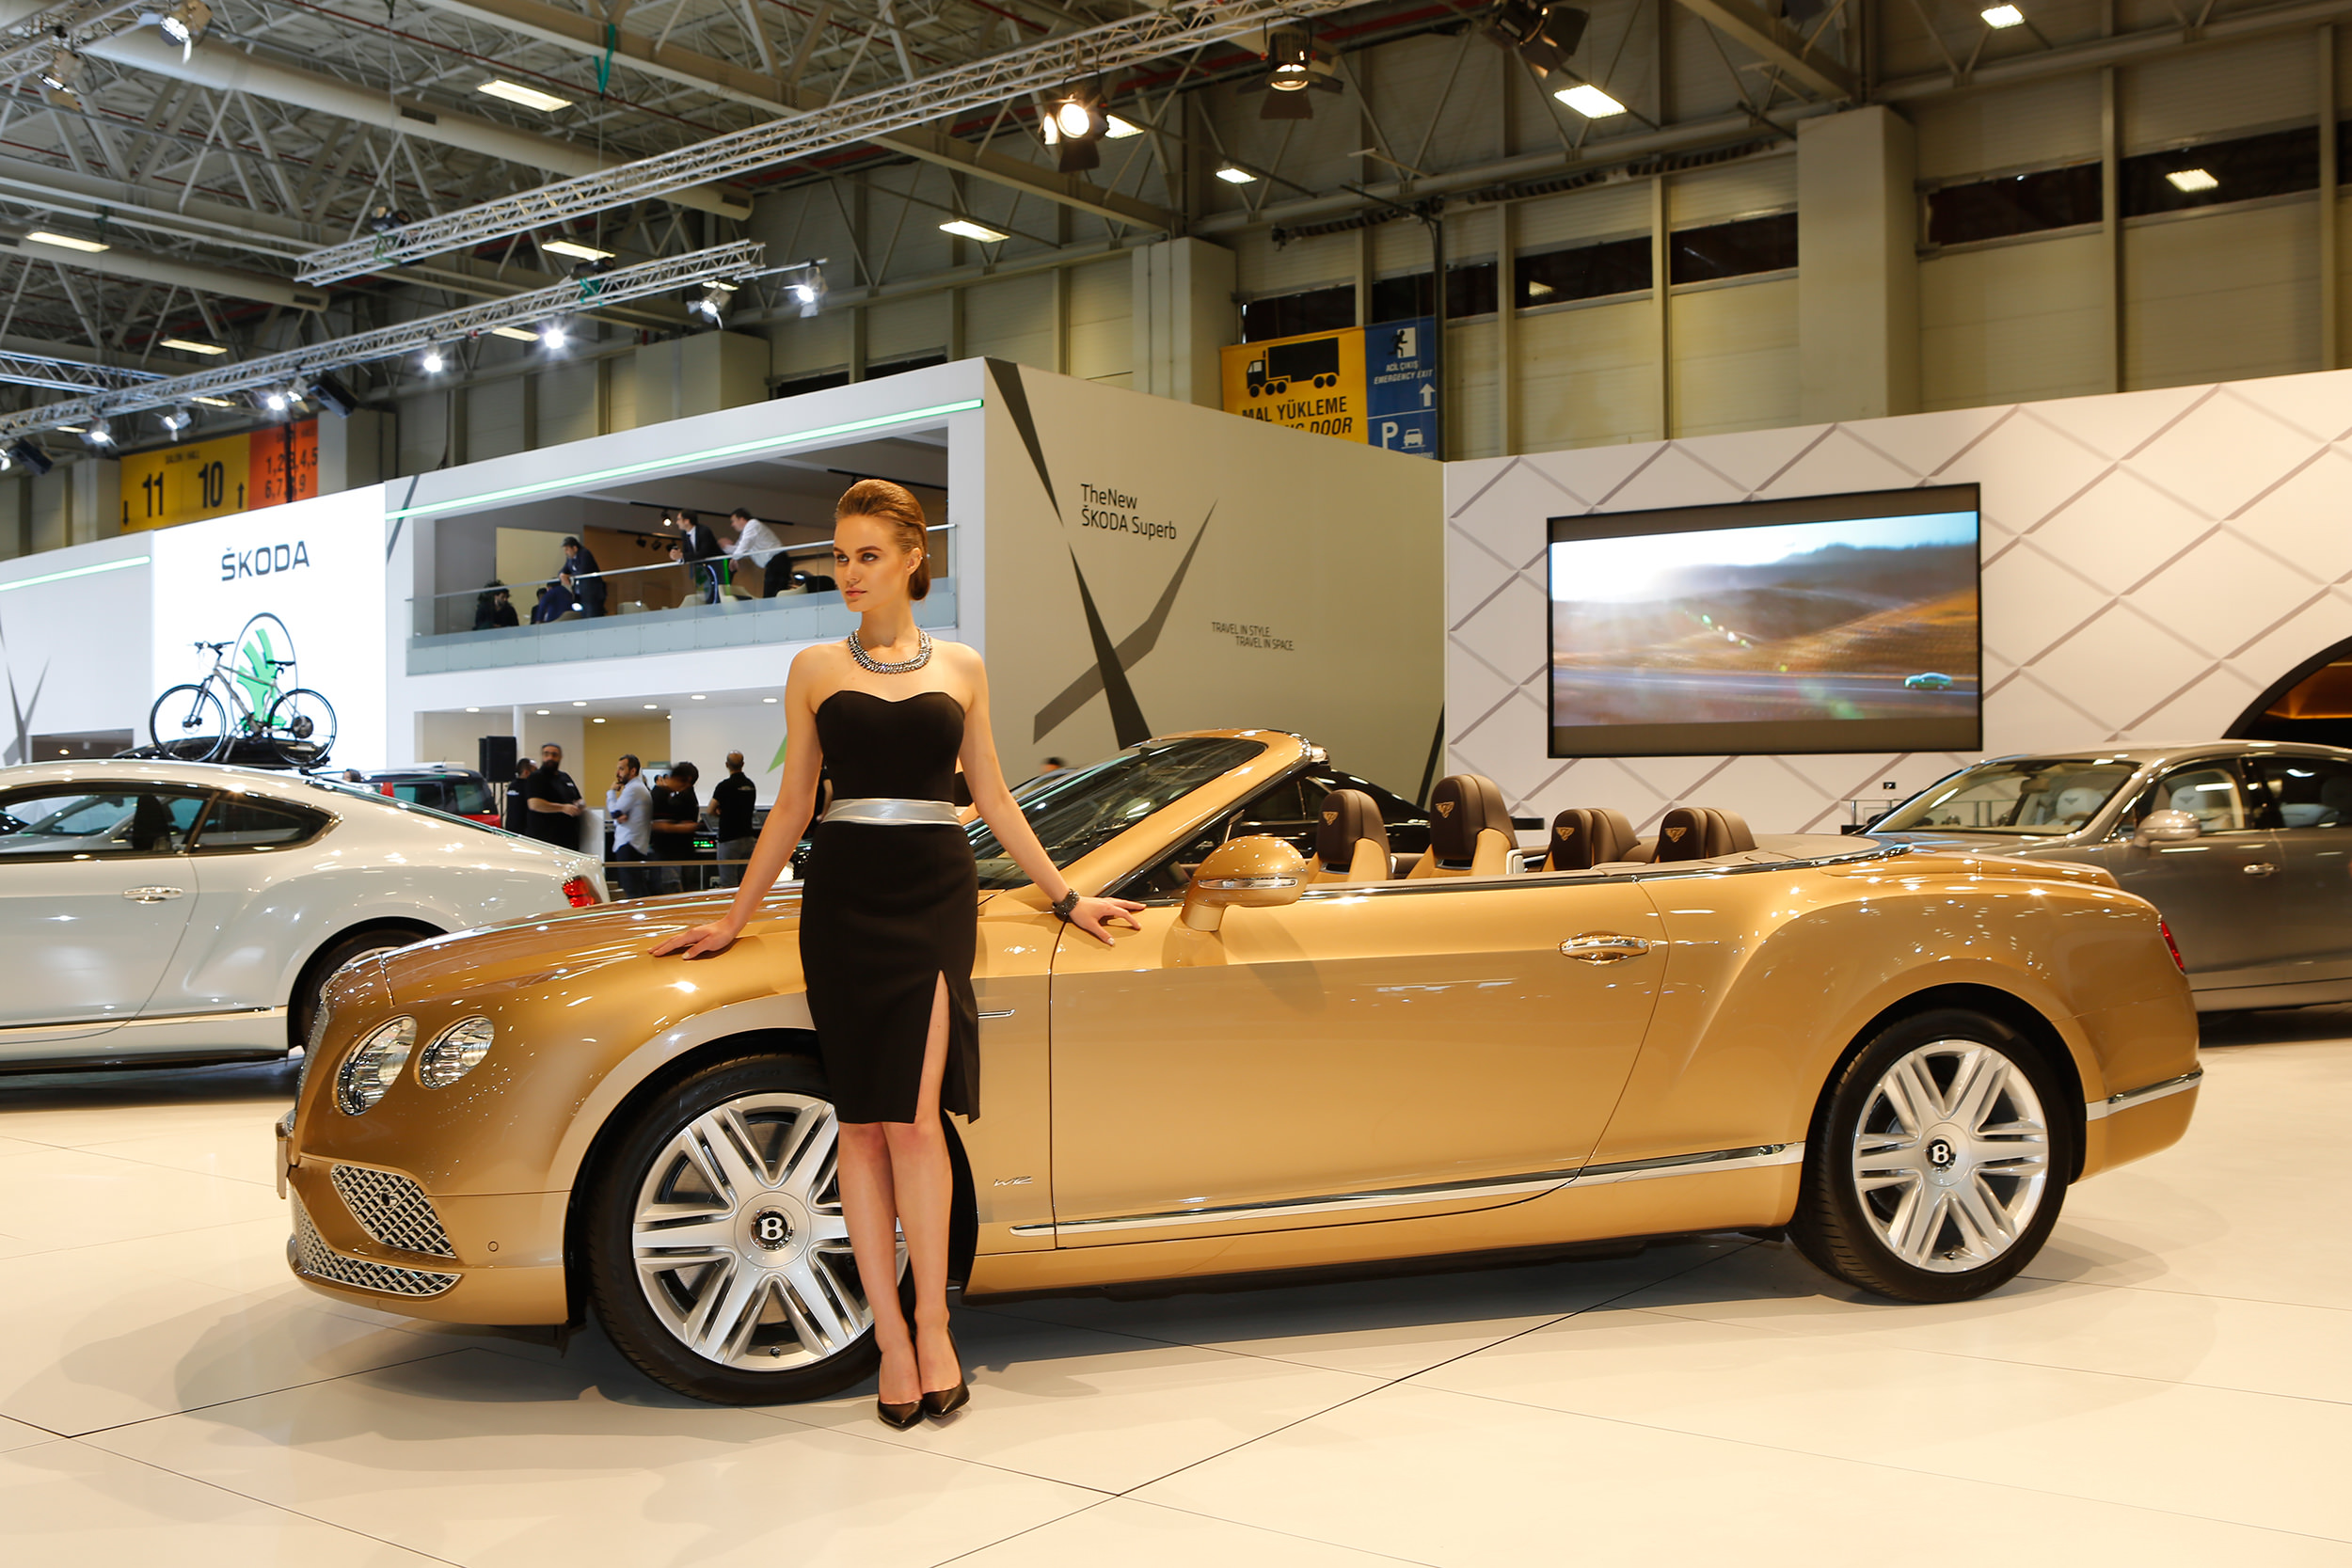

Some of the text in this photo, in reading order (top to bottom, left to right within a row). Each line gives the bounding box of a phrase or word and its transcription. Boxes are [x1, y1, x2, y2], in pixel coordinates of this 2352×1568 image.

[1374, 369, 1434, 385] EMERGENCY EXIT
[1277, 396, 1347, 421] YÜKLEME
[1310, 417, 1353, 436] DOOR
[1382, 421, 1399, 450] P
[143, 472, 164, 517] 11
[199, 461, 224, 508] 10
[1081, 483, 1137, 509] TheNew
[1081, 504, 1177, 541] ŠKODA Superb
[221, 540, 310, 581] ŠKODA
[1212, 622, 1238, 634] TRAVEL
[1240, 625, 1248, 635] IN
[1235, 636, 1262, 648] TRAVEL
[1263, 639, 1271, 648] IN
[1931, 1144, 1949, 1164] B
[760, 1217, 784, 1240] B
